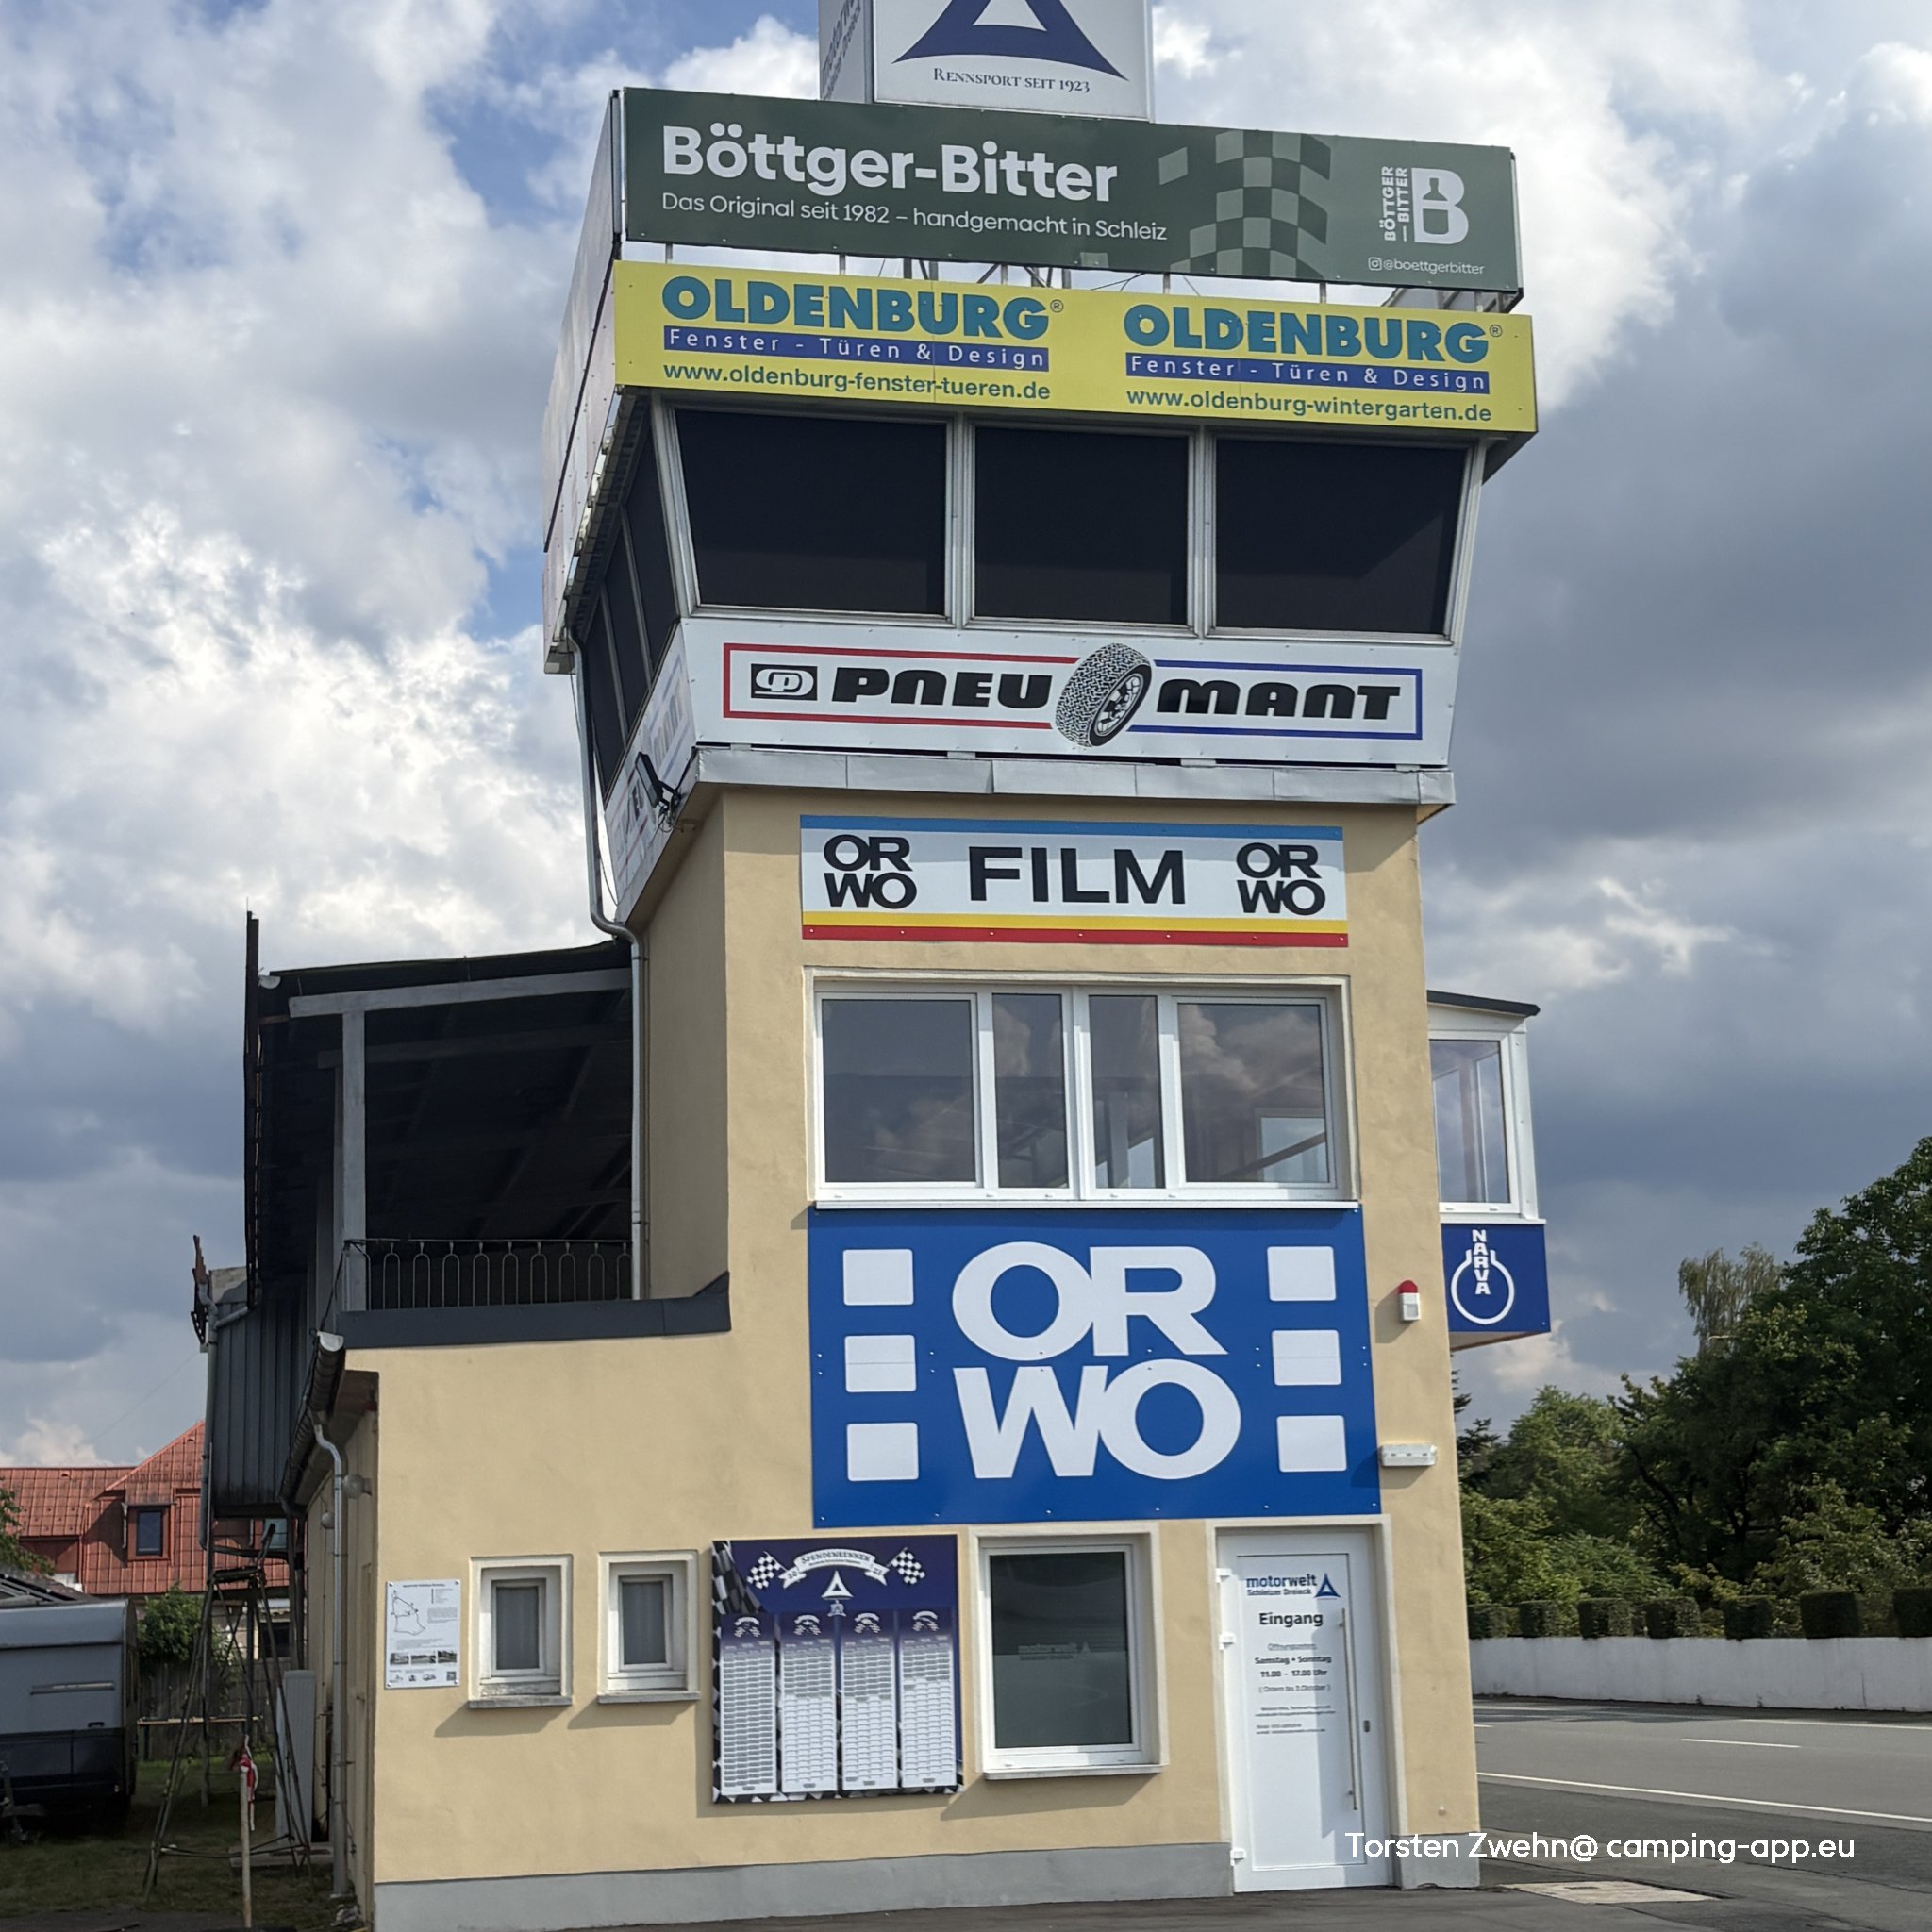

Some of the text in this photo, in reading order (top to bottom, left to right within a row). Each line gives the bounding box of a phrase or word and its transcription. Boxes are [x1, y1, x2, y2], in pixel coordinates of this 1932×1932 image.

[1024, 77, 1056, 90] SEIT
[1059, 79, 1091, 94] 1923
[662, 122, 1118, 202] Böttger-Bitter
[1379, 166, 1396, 242] BÖTTGER
[1395, 167, 1410, 223] BITTER
[662, 192, 705, 211] Das
[710, 194, 795, 219] Original
[800, 200, 839, 221] seit
[843, 203, 890, 224] 1982
[913, 208, 1068, 235] handgemacht
[1072, 218, 1091, 236] in
[1094, 219, 1168, 242] Schleiz
[1383, 258, 1485, 275] @boettgerbitter
[670, 328, 779, 352] Fenster
[820, 338, 900, 359] Türen
[917, 343, 932, 360] &
[948, 345, 1044, 370] Design
[663, 363, 1051, 400] www.oldenburg-fenster-tueren.de
[1131, 356, 1234, 376] Fenster
[1272, 362, 1348, 383] Türen
[1364, 368, 1378, 384] &
[1394, 370, 1485, 392] Design
[1126, 391, 1491, 423] www.oldenburg-wintergarten.de
[831, 666, 1052, 708] PNEU
[1157, 678, 1401, 720] MANT
[969, 845, 1186, 905] FILM
[1472, 1229, 1491, 1295] NARVA
[1246, 1573, 1317, 1588] motorwelt
[1258, 1611, 1324, 1628] Eingang
